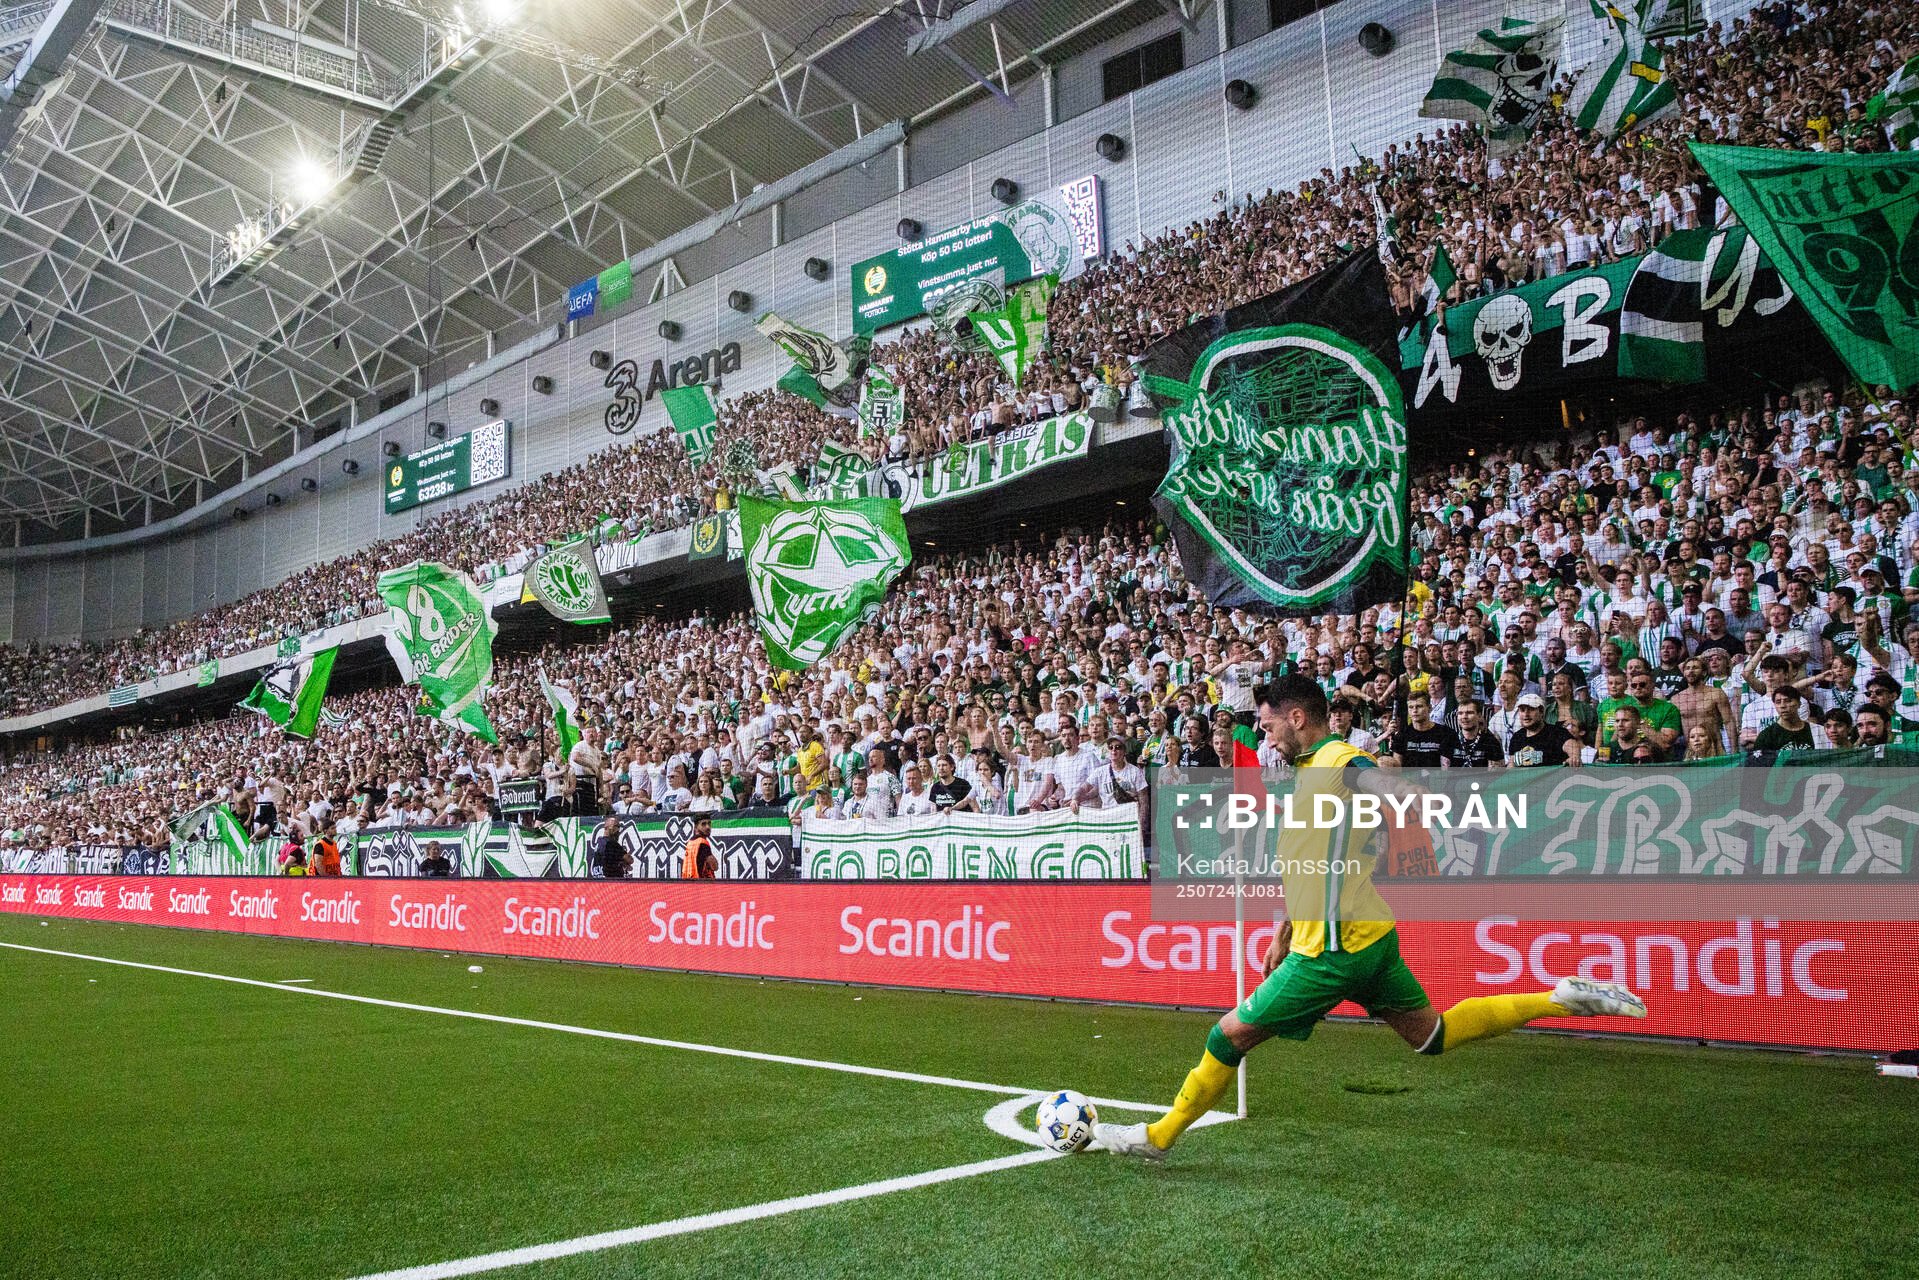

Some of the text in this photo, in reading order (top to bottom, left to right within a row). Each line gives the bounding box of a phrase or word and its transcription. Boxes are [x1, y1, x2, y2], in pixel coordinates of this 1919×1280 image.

[897, 242, 924, 257] Stötta
[925, 224, 971, 248] Hammarby
[921, 248, 938, 263] Köp
[939, 244, 951, 256] 50
[952, 239, 964, 252] 50
[607, 276, 630, 291] RESPECT
[917, 256, 999, 290] Vinstsumma just nu:
[569, 291, 594, 312] UEFA
[858, 295, 895, 313] HAMMARBY
[864, 306, 889, 319] FOTBOLL
[645, 341, 742, 402] Arena
[418, 481, 455, 502] 63238 kr
[500, 788, 536, 805] Söderort
[2, 883, 25, 903] Scandic
[35, 884, 62, 905] Scandic
[73, 885, 105, 908] Scandic
[117, 886, 154, 911] Scandic
[168, 888, 211, 915] Scandic
[229, 890, 279, 919] Scandic
[300, 892, 361, 924] Scandic
[389, 895, 467, 931] Scandic
[503, 897, 601, 940] Scandic
[648, 901, 775, 949] Scandic
[840, 906, 1010, 962] Scandic
[1474, 915, 1848, 1000] Scandic
[1060, 1127, 1085, 1152] SELECT
